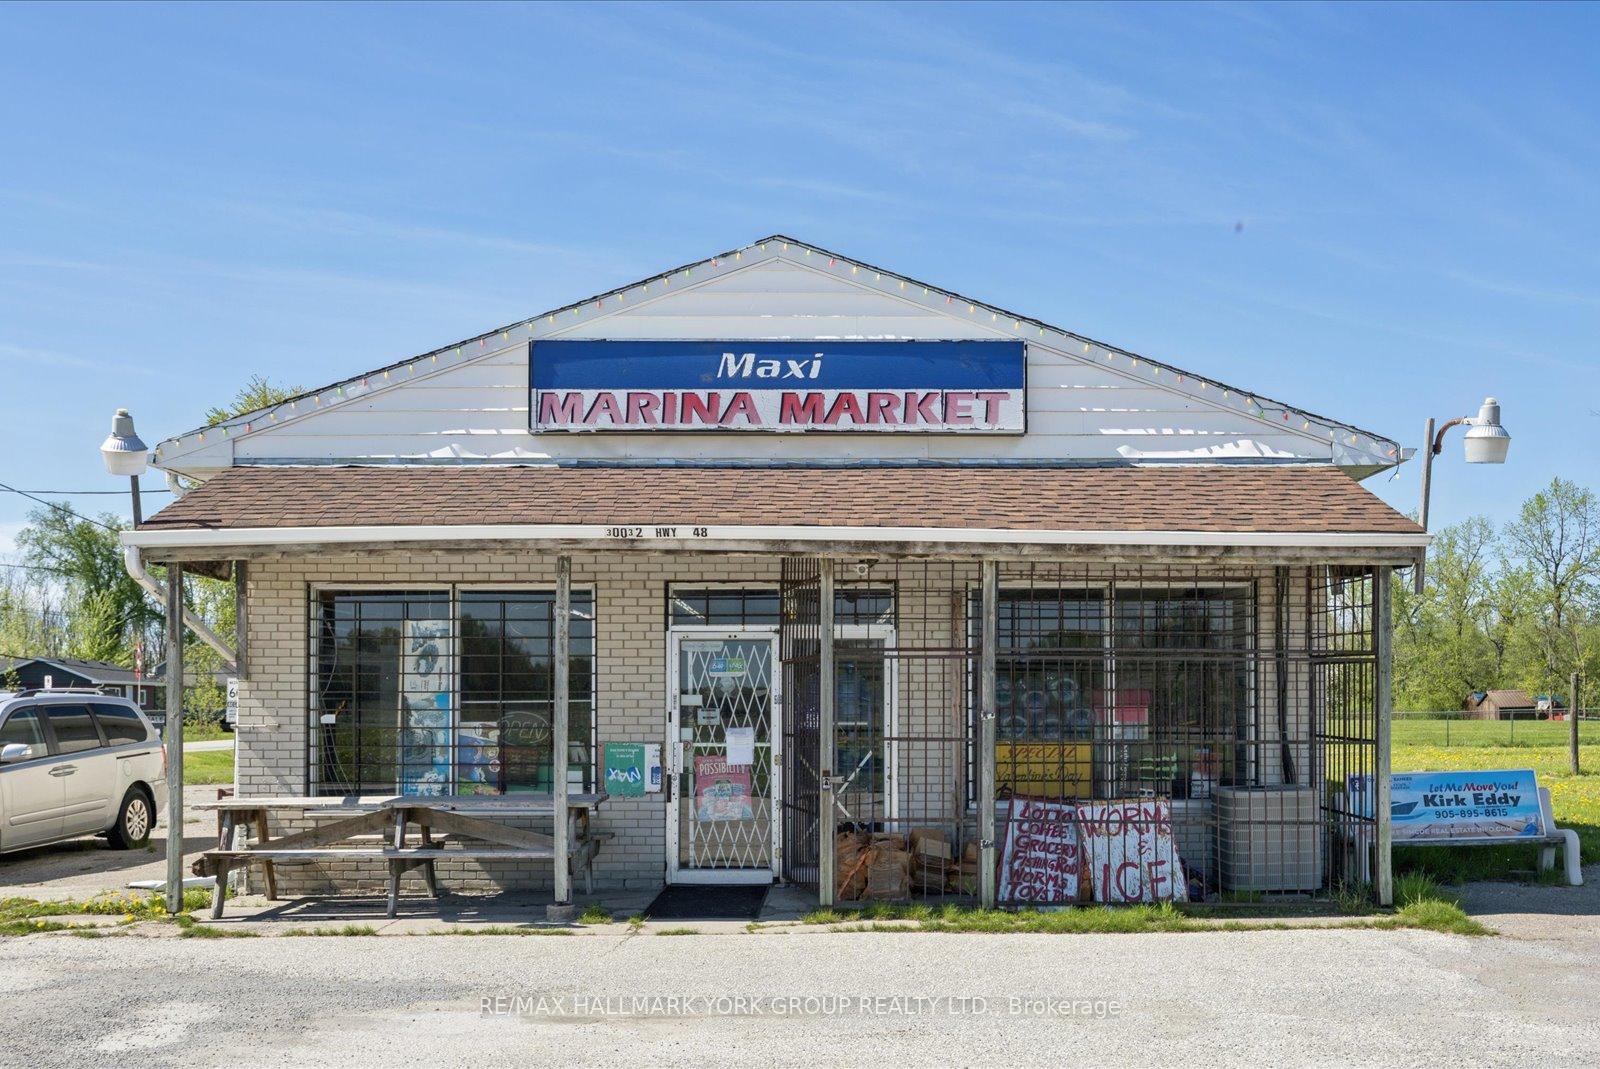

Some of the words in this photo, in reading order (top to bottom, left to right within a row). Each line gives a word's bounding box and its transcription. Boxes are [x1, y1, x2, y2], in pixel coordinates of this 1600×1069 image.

[717, 352, 824, 379] Maxi
[538, 391, 762, 425] MARINA
[779, 391, 1010, 425] MARKET
[606, 527, 643, 538] 30032
[655, 527, 677, 538] HWY
[692, 527, 708, 538] 48
[699, 761, 746, 777] POSSIBILITY
[1429, 783, 1443, 793] Let
[1463, 782, 1493, 792] Move
[1493, 781, 1519, 793] You!
[1423, 793, 1467, 808] Kirk
[1472, 792, 1521, 808] Eddy
[1434, 808, 1508, 819] 905-895-8615
